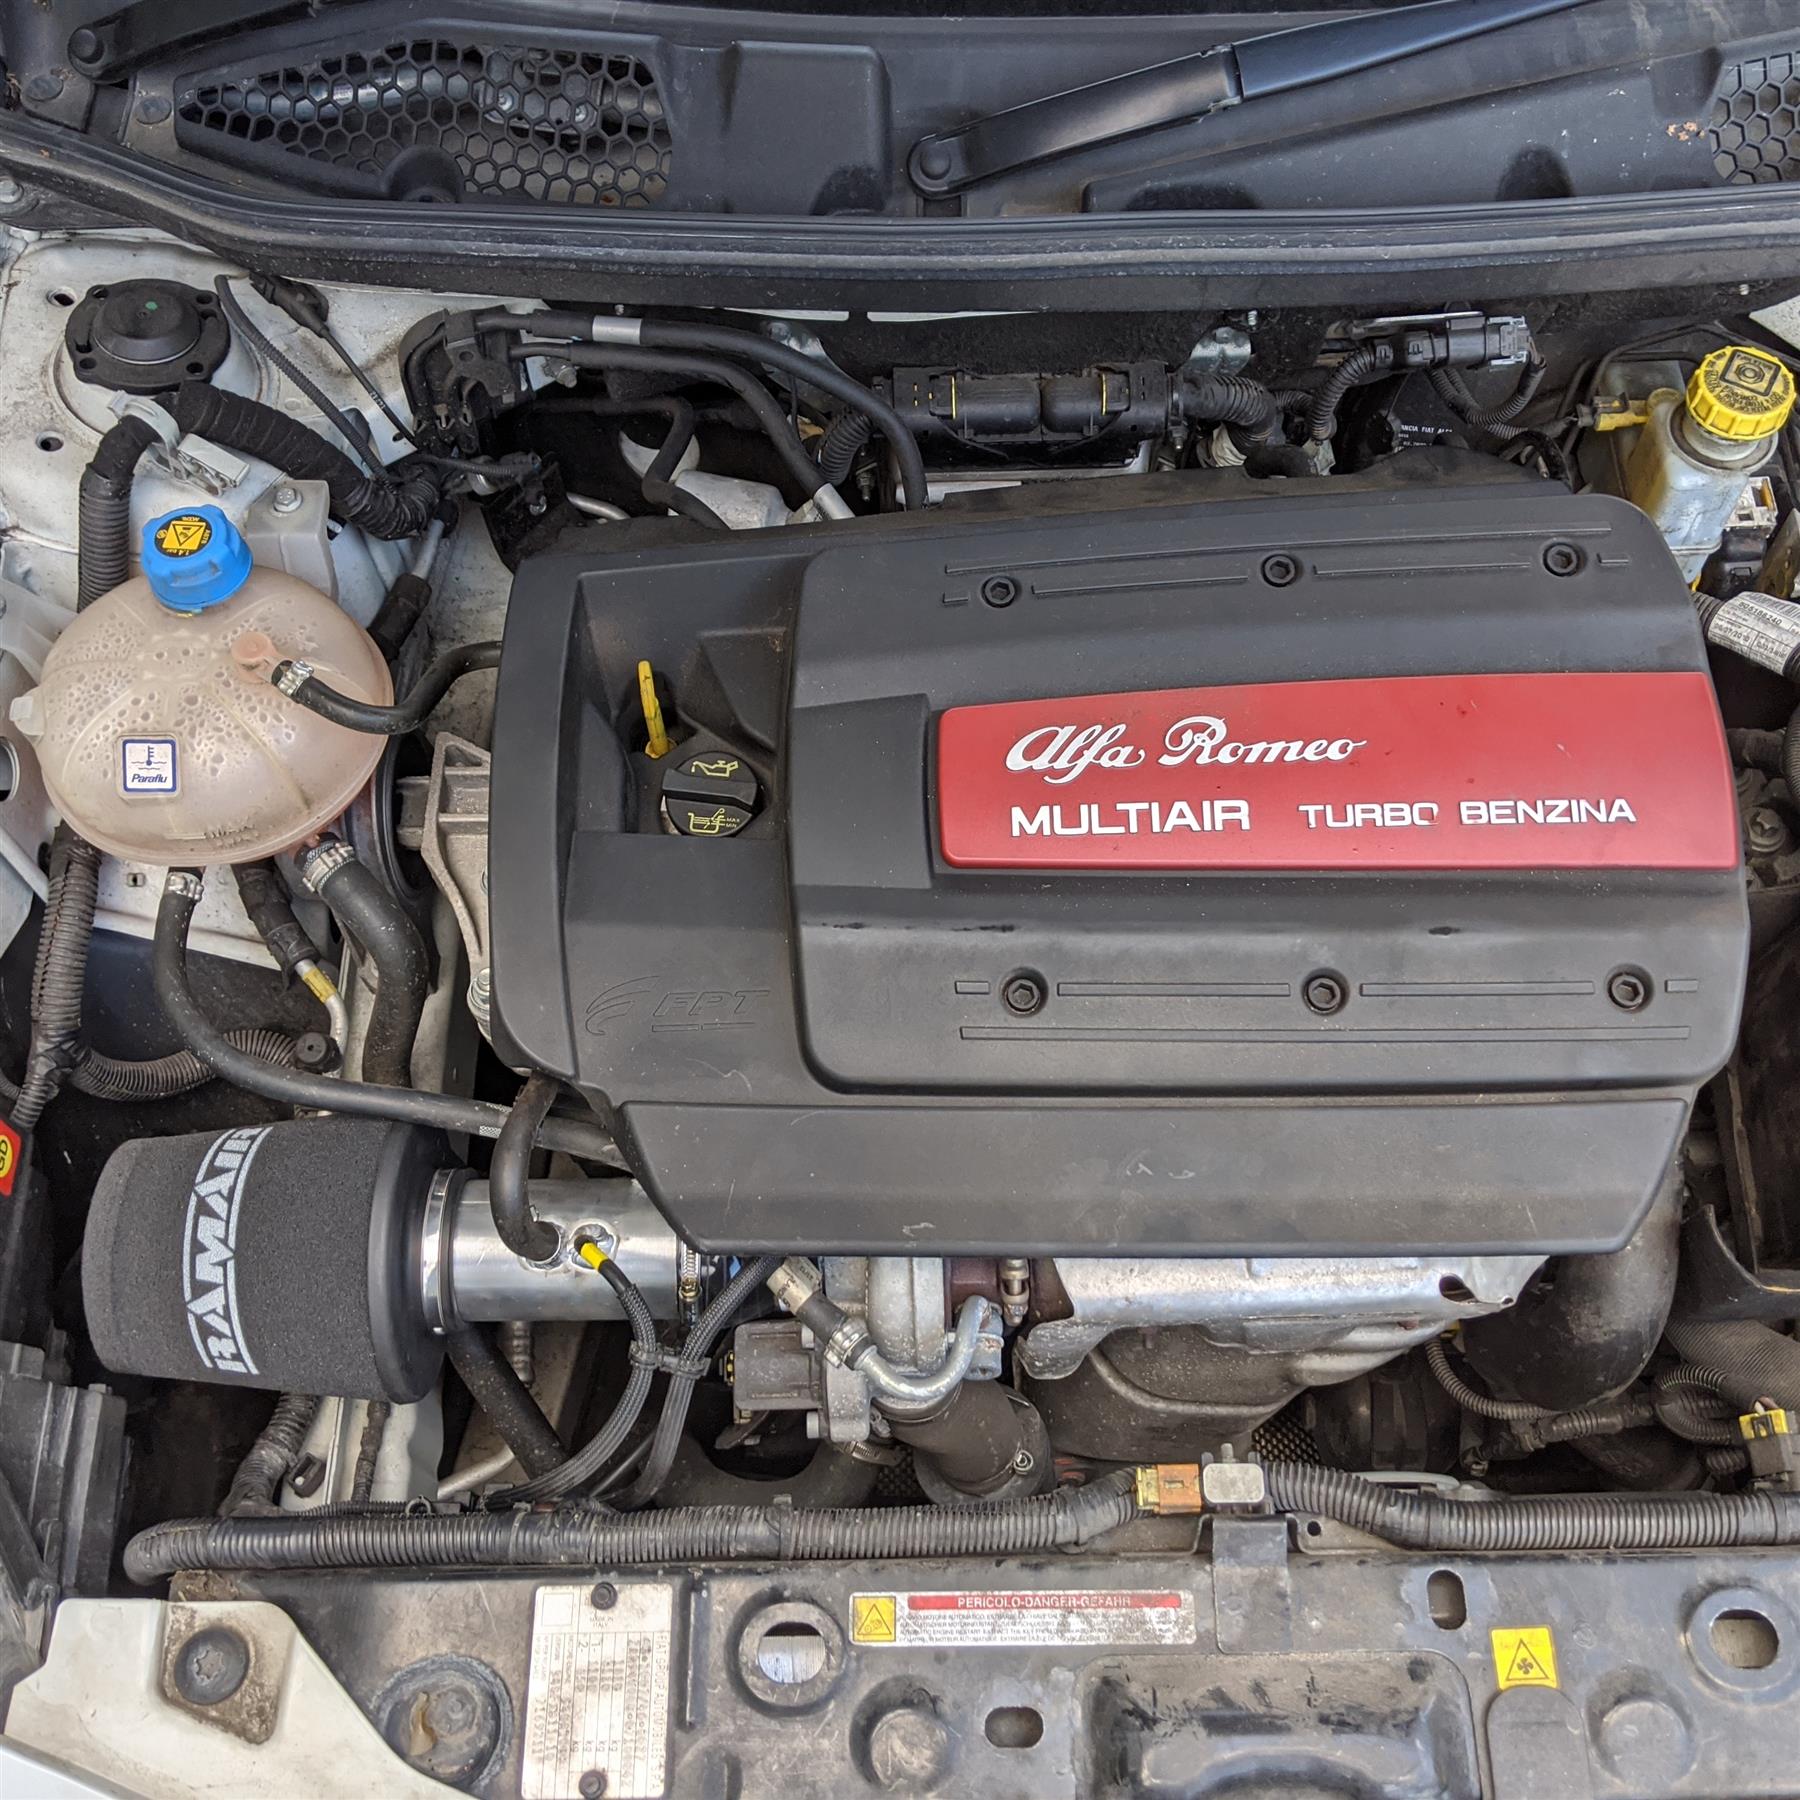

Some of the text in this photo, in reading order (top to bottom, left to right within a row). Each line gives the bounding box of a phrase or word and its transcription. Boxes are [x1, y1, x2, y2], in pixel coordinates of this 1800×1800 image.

[1005, 715, 1367, 784] Alfa Romeo
[131, 773, 168, 784] Paraflu
[1010, 798, 1637, 837] MULTIAIR TURBO BENZINA
[652, 990, 771, 1017] FPT
[185, 1127, 264, 1375] RAMAIR
[957, 1596, 1131, 1609] PERICOLO-DANGER-GEFAHR
[655, 1635, 669, 1655] FIAT
[654, 1657, 667, 1690] GROUP
